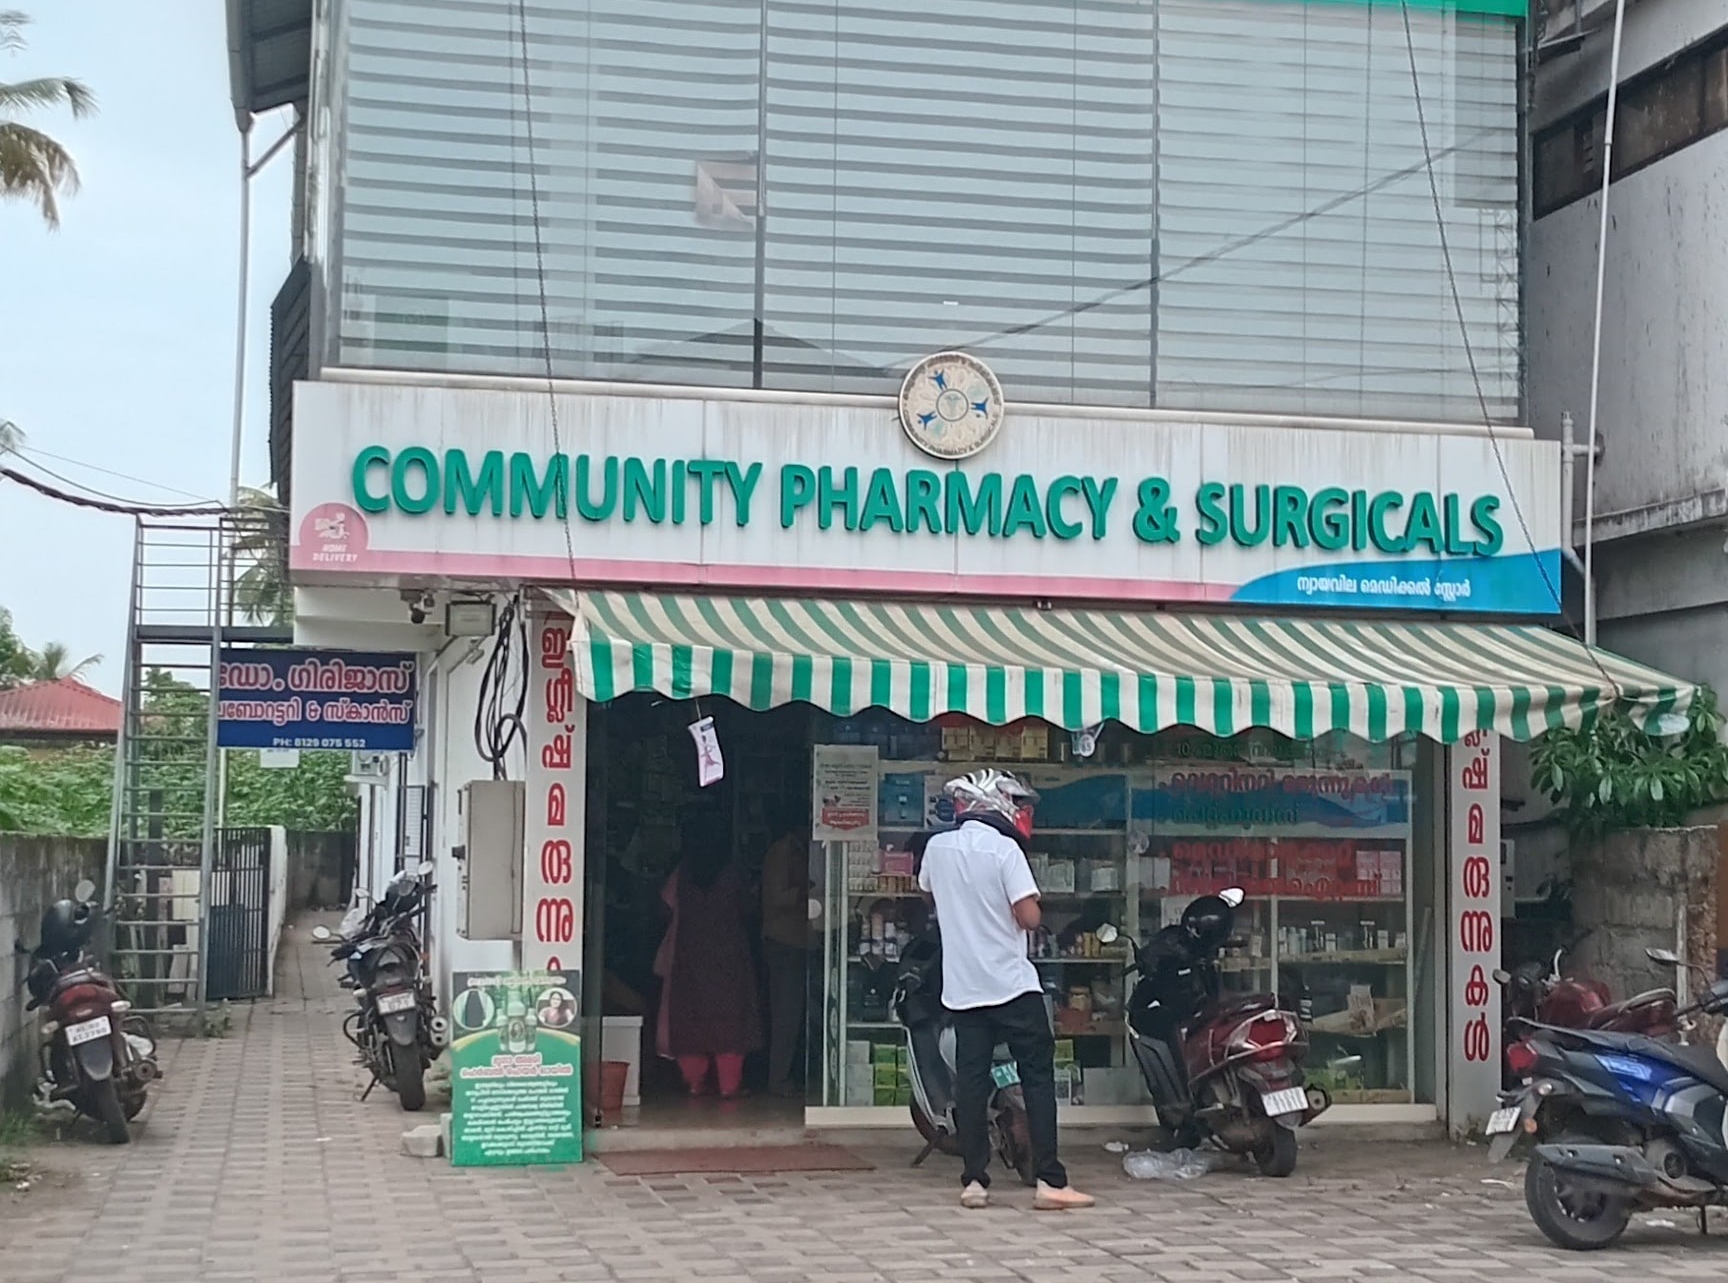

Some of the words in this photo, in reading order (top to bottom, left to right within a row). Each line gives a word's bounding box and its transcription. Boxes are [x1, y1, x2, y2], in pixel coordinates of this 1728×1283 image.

[352, 445, 763, 527] COMMUNITY
[780, 464, 1118, 541] PHARMACY
[1133, 476, 1181, 545] &
[1195, 481, 1505, 555] SURGICALS
[312, 552, 358, 563] DELIVERY
[1297, 573, 1358, 597] ന്യായവില
[288, 657, 415, 694] ഗിരിജാസ്
[306, 700, 321, 722] &
[323, 696, 414, 724] സ്കാൻസ്
[541, 626, 576, 770] ഇഗ്ലീഷ്
[272, 737, 293, 747] PH:
